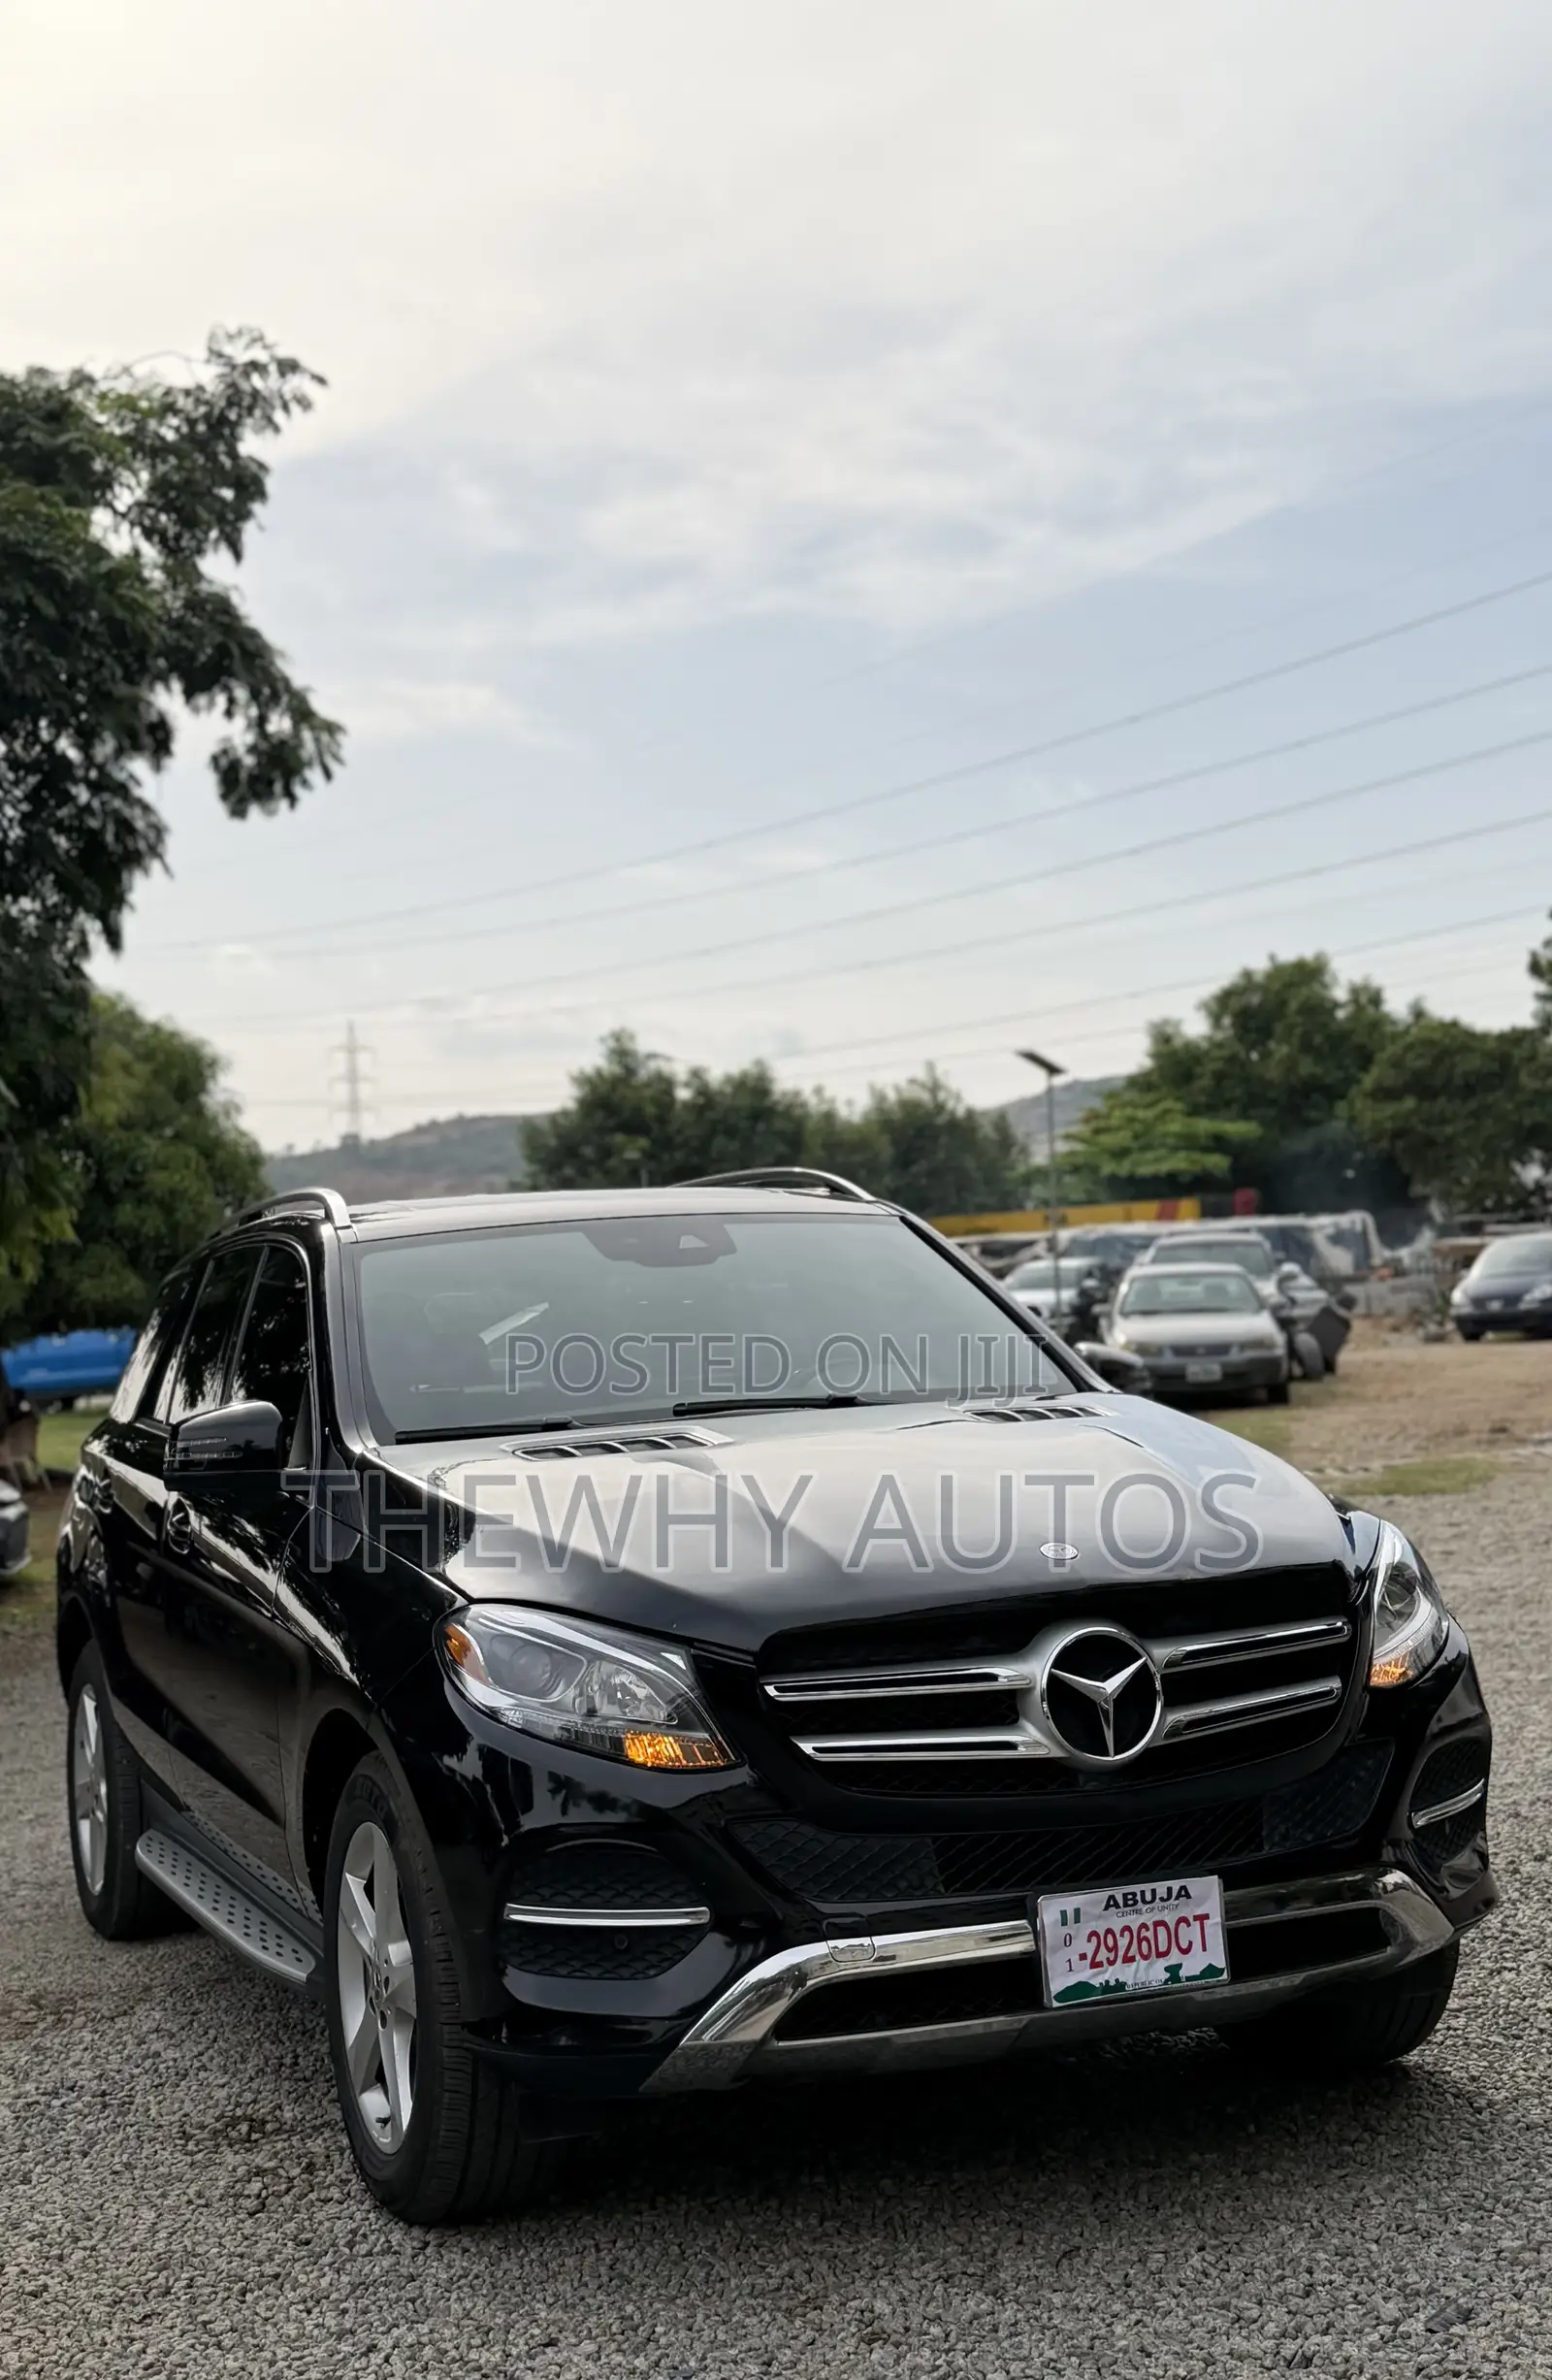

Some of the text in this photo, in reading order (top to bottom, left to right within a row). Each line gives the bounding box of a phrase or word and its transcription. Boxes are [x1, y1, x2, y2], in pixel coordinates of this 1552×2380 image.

[1103, 1885, 1192, 1911] ABUJA
[1116, 1908, 1144, 1918] CENTRE
[1157, 1903, 1180, 1912] UNITY
